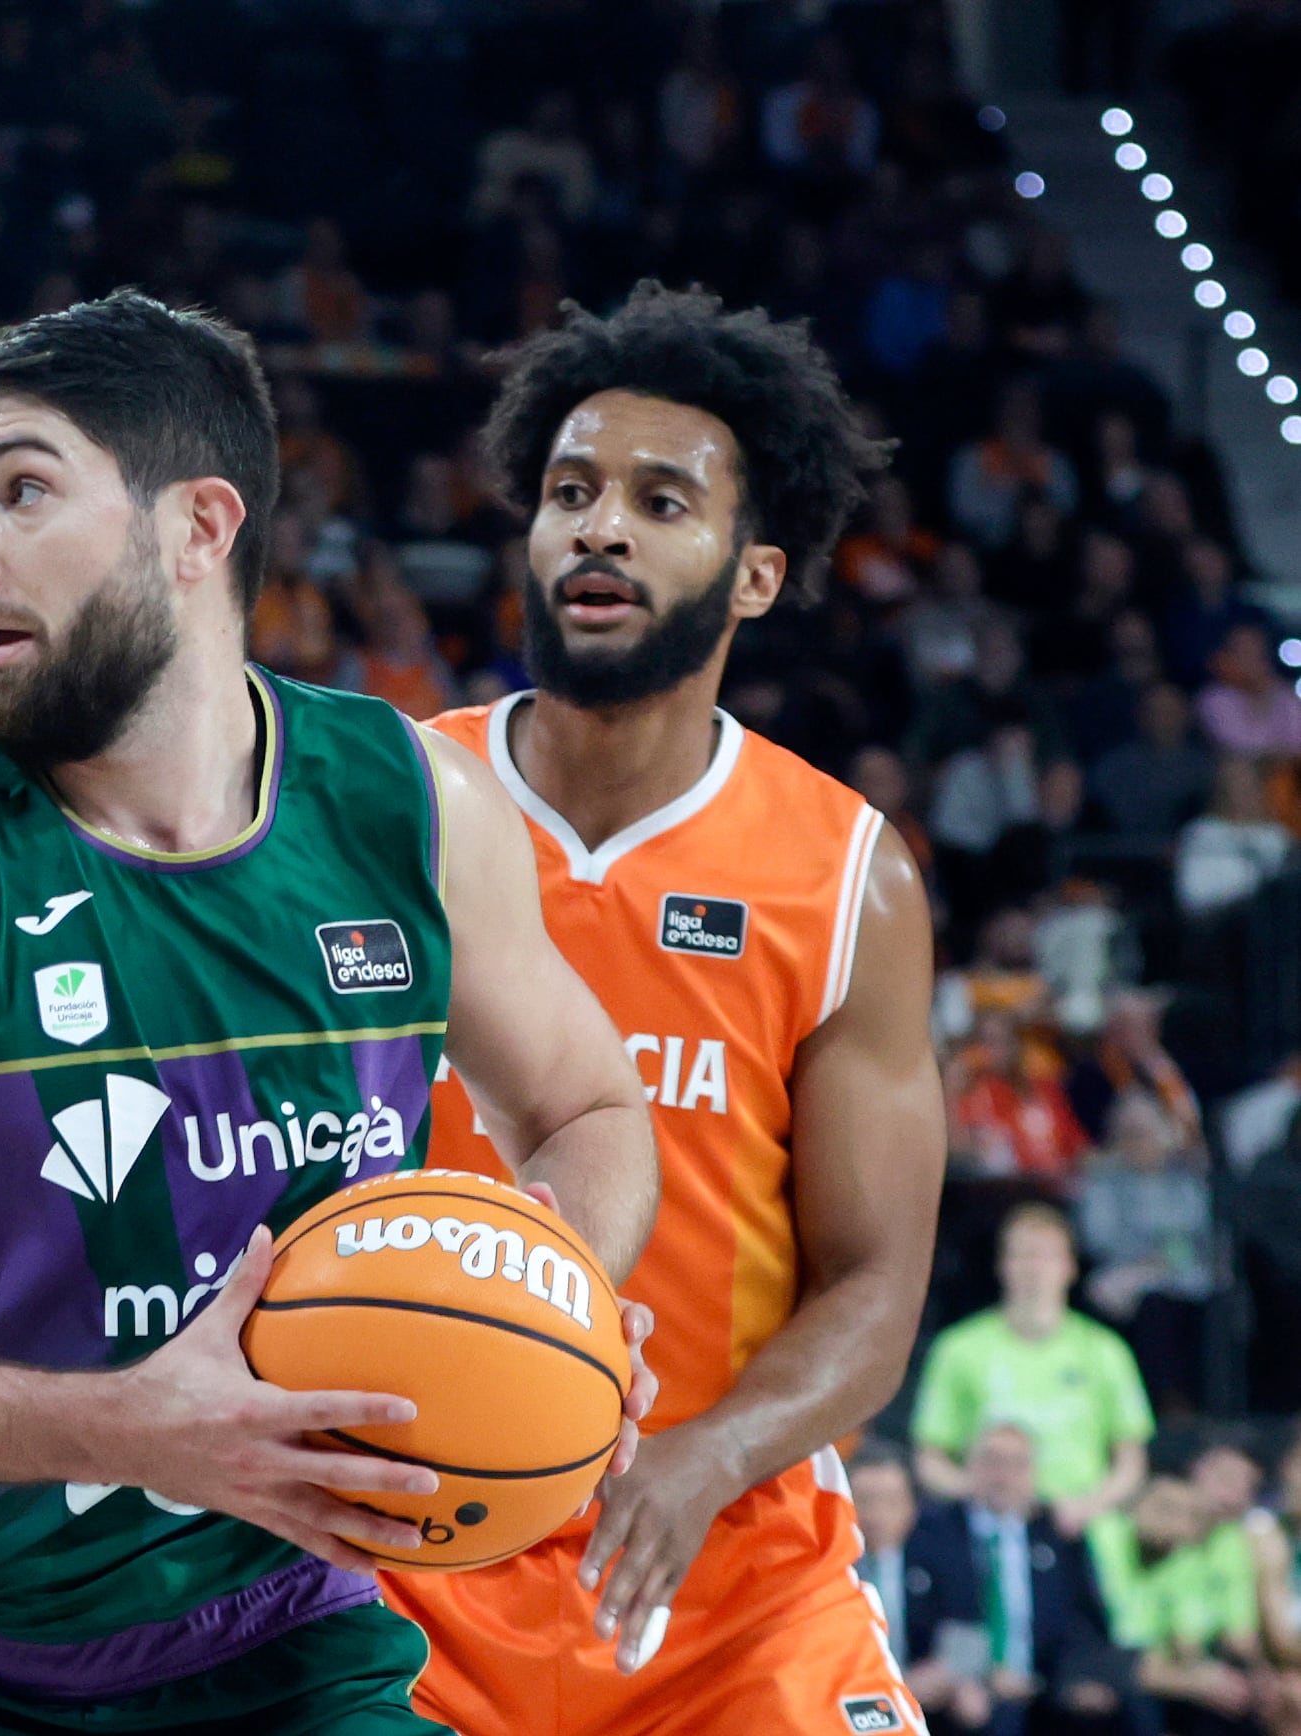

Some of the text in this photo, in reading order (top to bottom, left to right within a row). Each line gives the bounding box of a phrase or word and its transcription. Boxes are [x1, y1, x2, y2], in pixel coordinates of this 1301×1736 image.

[667, 911, 702, 930] liga
[666, 929, 738, 950] endesa
[331, 944, 366, 965] liga
[338, 961, 406, 982] endesa
[49, 1000, 98, 1012] Fundación
[58, 1011, 93, 1022] Unicaja
[335, 1214, 593, 1331] Wilson
